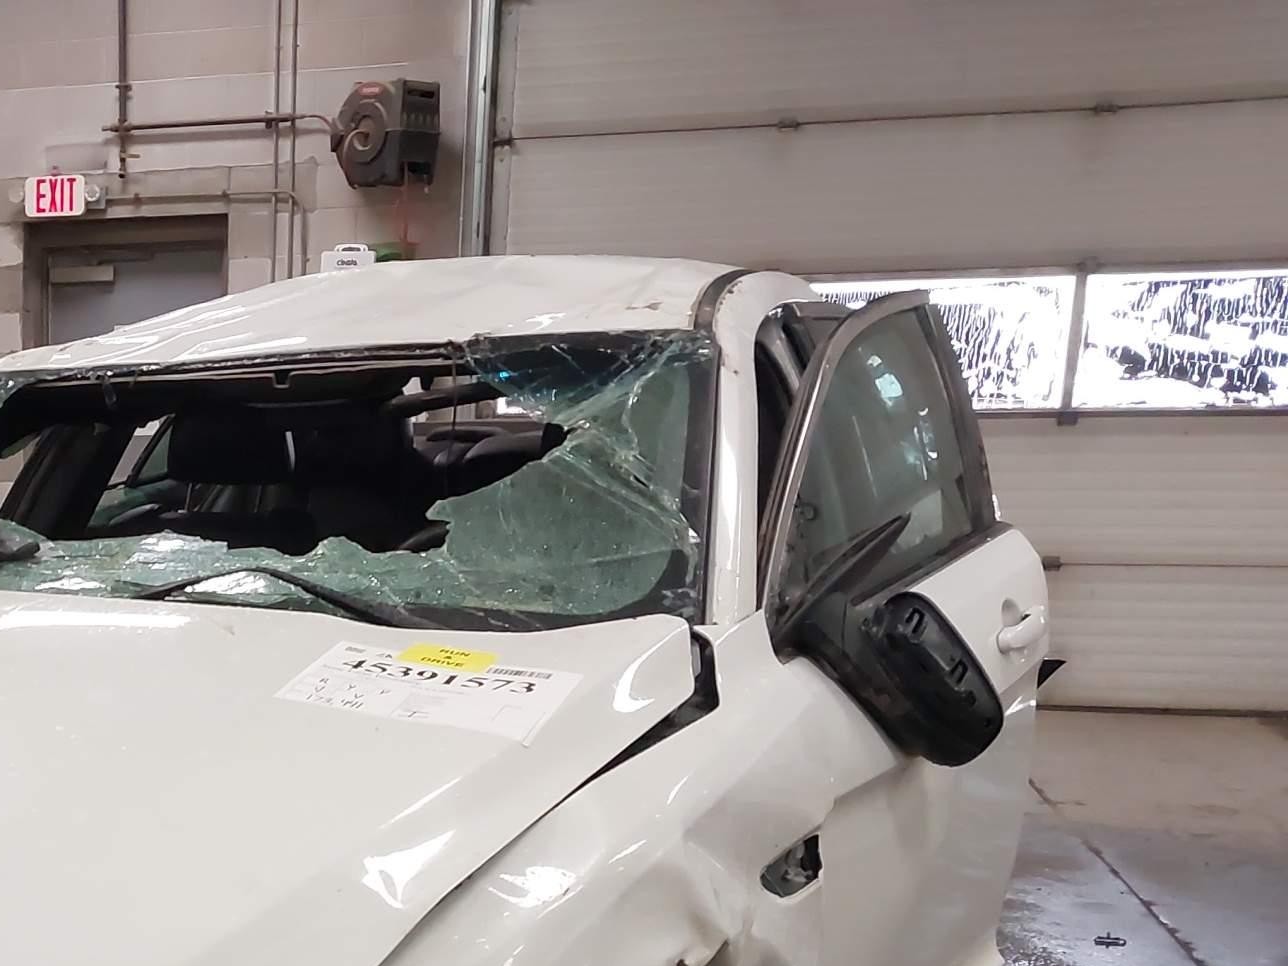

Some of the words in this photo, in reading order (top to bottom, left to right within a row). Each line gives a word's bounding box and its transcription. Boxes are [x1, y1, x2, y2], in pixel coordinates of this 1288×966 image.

[35, 177, 77, 213] EXIT
[342, 659, 537, 694] 45391573
[420, 656, 464, 667] DRIVE
